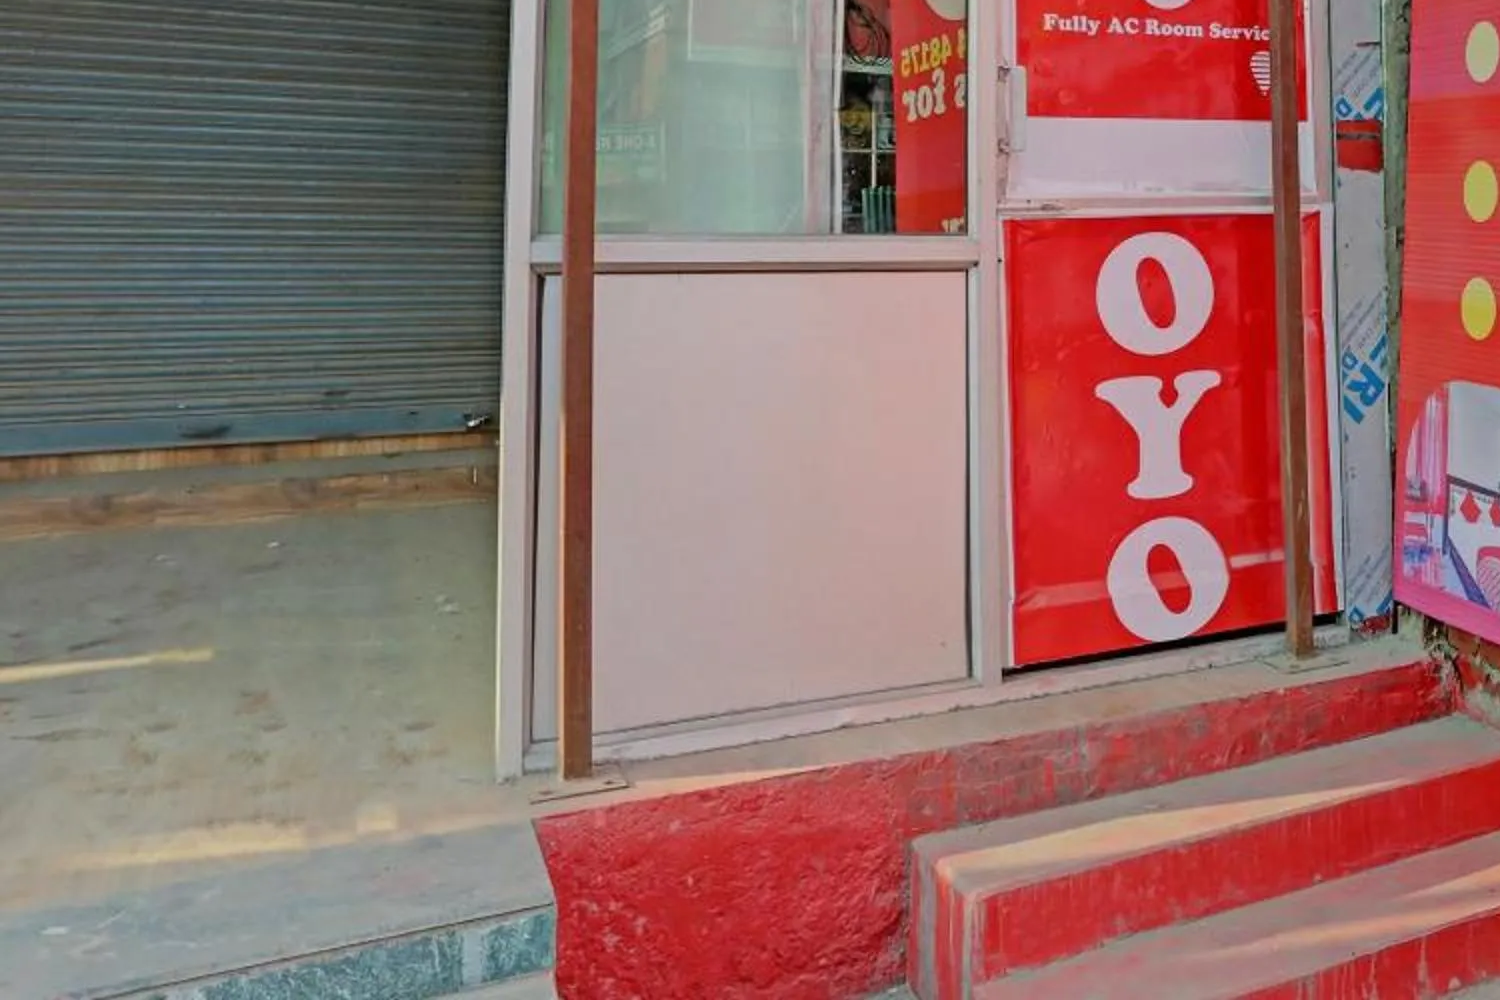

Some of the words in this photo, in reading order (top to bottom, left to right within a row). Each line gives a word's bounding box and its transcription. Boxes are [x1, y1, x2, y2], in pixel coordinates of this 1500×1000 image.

[1043, 13, 1100, 36] Fully
[1107, 17, 1139, 35] AC
[1145, 18, 1203, 38] Room
[1209, 23, 1270, 41] Servic
[1095, 231, 1230, 642] OYO
